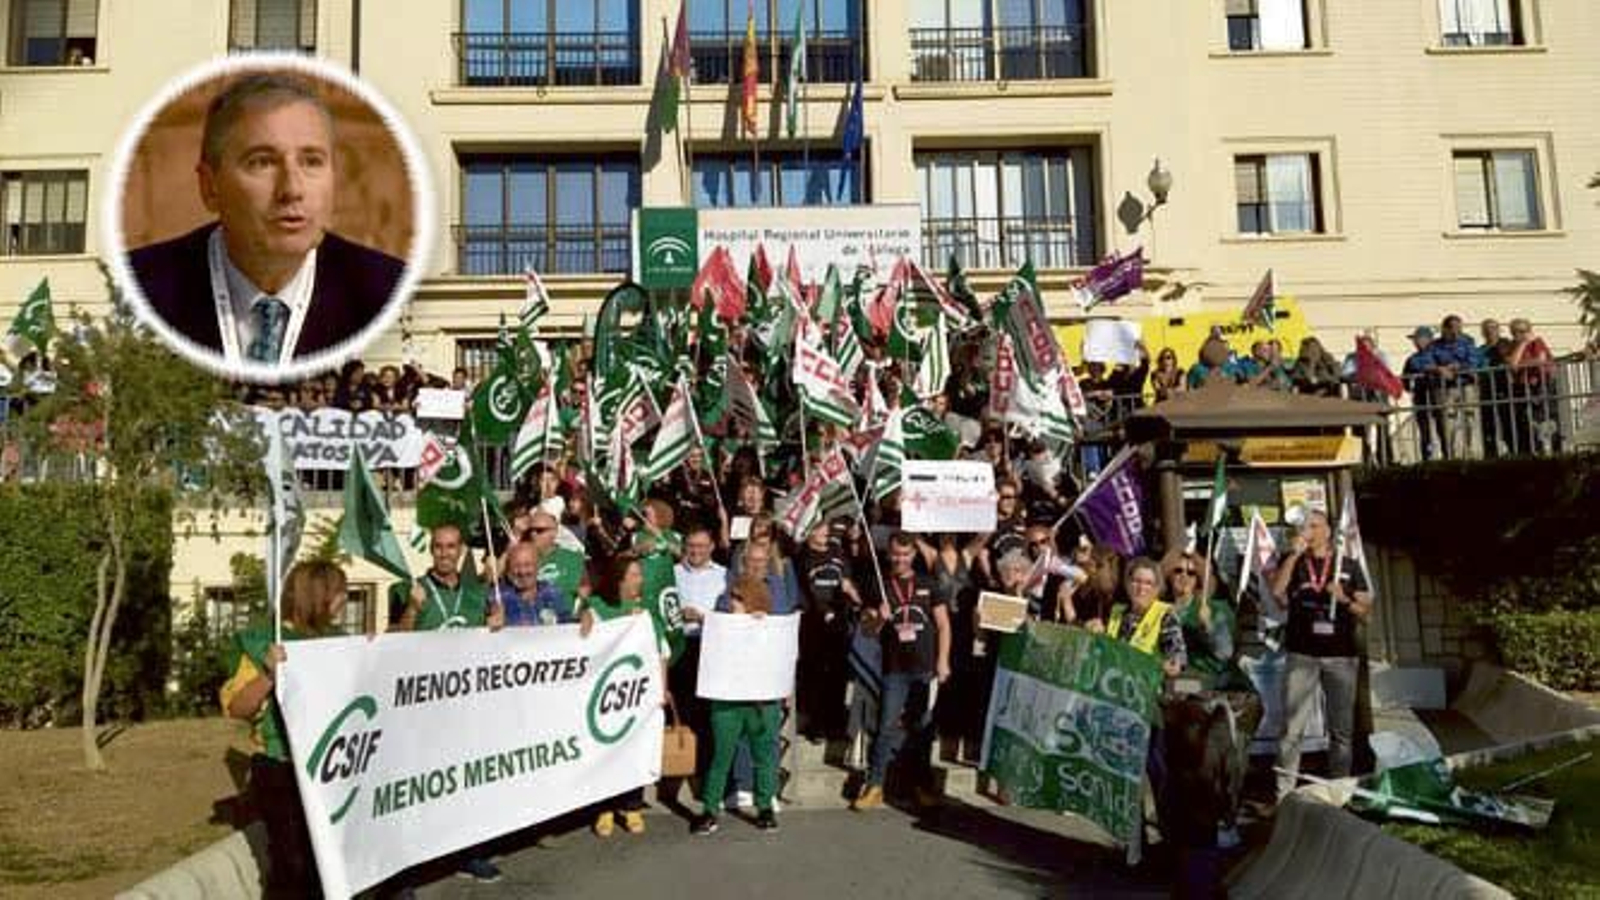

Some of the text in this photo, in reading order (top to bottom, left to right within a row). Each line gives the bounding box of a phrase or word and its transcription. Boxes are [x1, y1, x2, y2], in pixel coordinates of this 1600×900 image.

[704, 229, 911, 243] Hospital Regional Universitario
[841, 245, 857, 256] de
[279, 413, 406, 441] CALIDAD
[291, 441, 350, 461] ATOS
[393, 655, 590, 708] MENOS RECORTES
[600, 676, 650, 714] CSIF
[320, 729, 382, 784] CSIF
[372, 736, 583, 819] MENOS MENTIRAS
